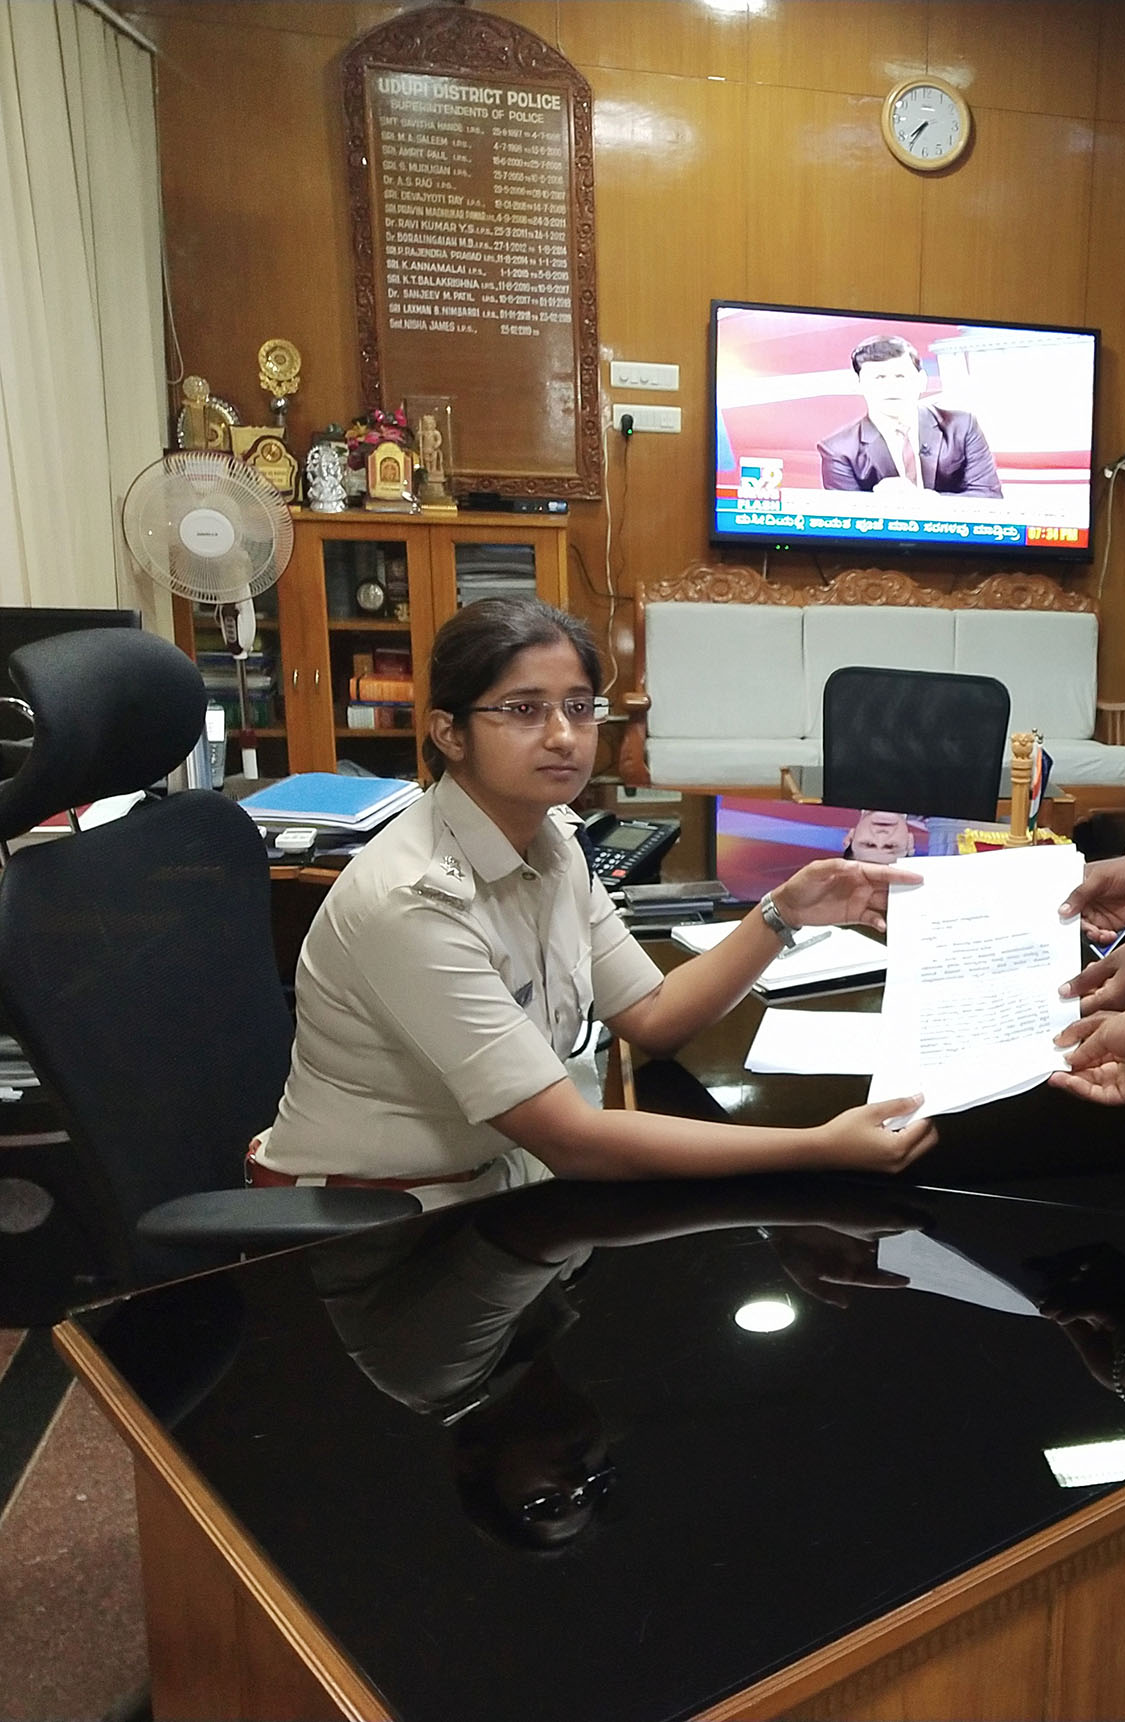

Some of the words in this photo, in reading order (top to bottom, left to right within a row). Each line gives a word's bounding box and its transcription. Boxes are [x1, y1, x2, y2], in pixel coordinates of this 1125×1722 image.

[378, 78, 428, 97] UDUPI
[433, 84, 503, 106] DISTRICT
[507, 92, 561, 111] POLICE
[391, 100, 488, 119] SUPERINTENDENTS
[492, 108, 504, 120] OF
[509, 110, 544, 124] POLICE
[416, 134, 448, 146] SALEEM
[427, 149, 448, 160] PAUL
[408, 162, 450, 175] MURUGAN
[415, 178, 432, 188] RAO
[401, 191, 446, 204] DEVAJYOTI
[448, 195, 464, 206] RAY
[398, 218, 418, 229] RAVI
[421, 220, 457, 232] KUMAR
[397, 232, 457, 246] BORALINGAIAH
[450, 250, 482, 262] PRASAD
[388, 288, 399, 298] Dr.
[403, 289, 440, 300] SANJEEV
[403, 304, 432, 315] LAXMAN
[429, 320, 455, 332] JAMES
[888, 522, 919, 532] ಮಾಡಿ
[1060, 528, 1079, 542] PM
